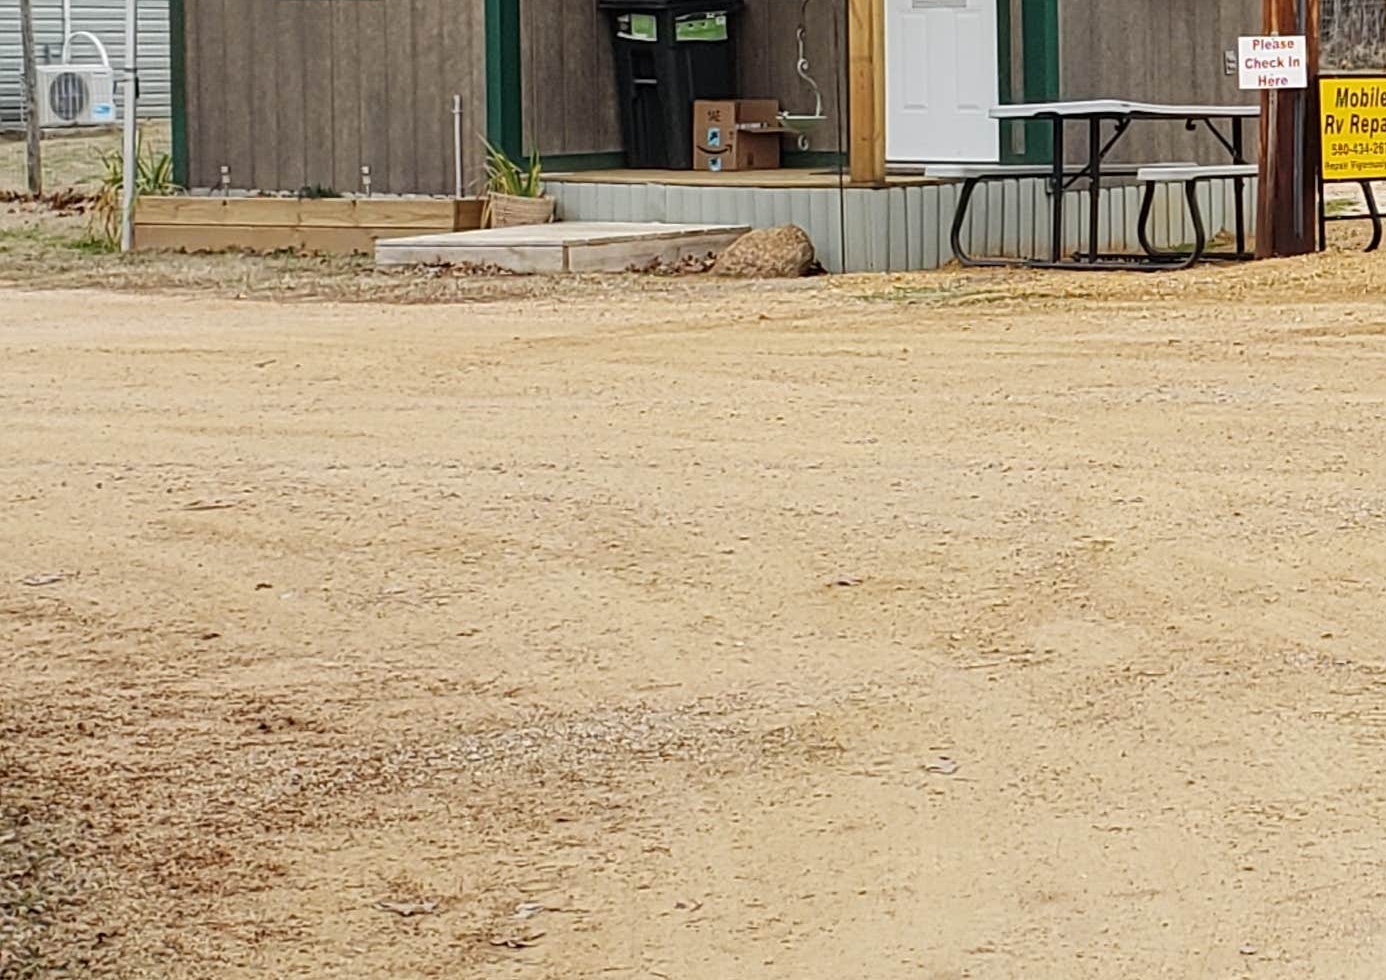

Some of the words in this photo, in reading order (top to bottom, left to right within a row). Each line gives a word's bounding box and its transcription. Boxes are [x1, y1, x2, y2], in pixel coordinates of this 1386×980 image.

[1252, 39, 1294, 51] Please
[1244, 57, 1284, 69] Check
[1288, 56, 1301, 67] In
[1258, 76, 1289, 86] Here
[1324, 114, 1344, 134] Rv
